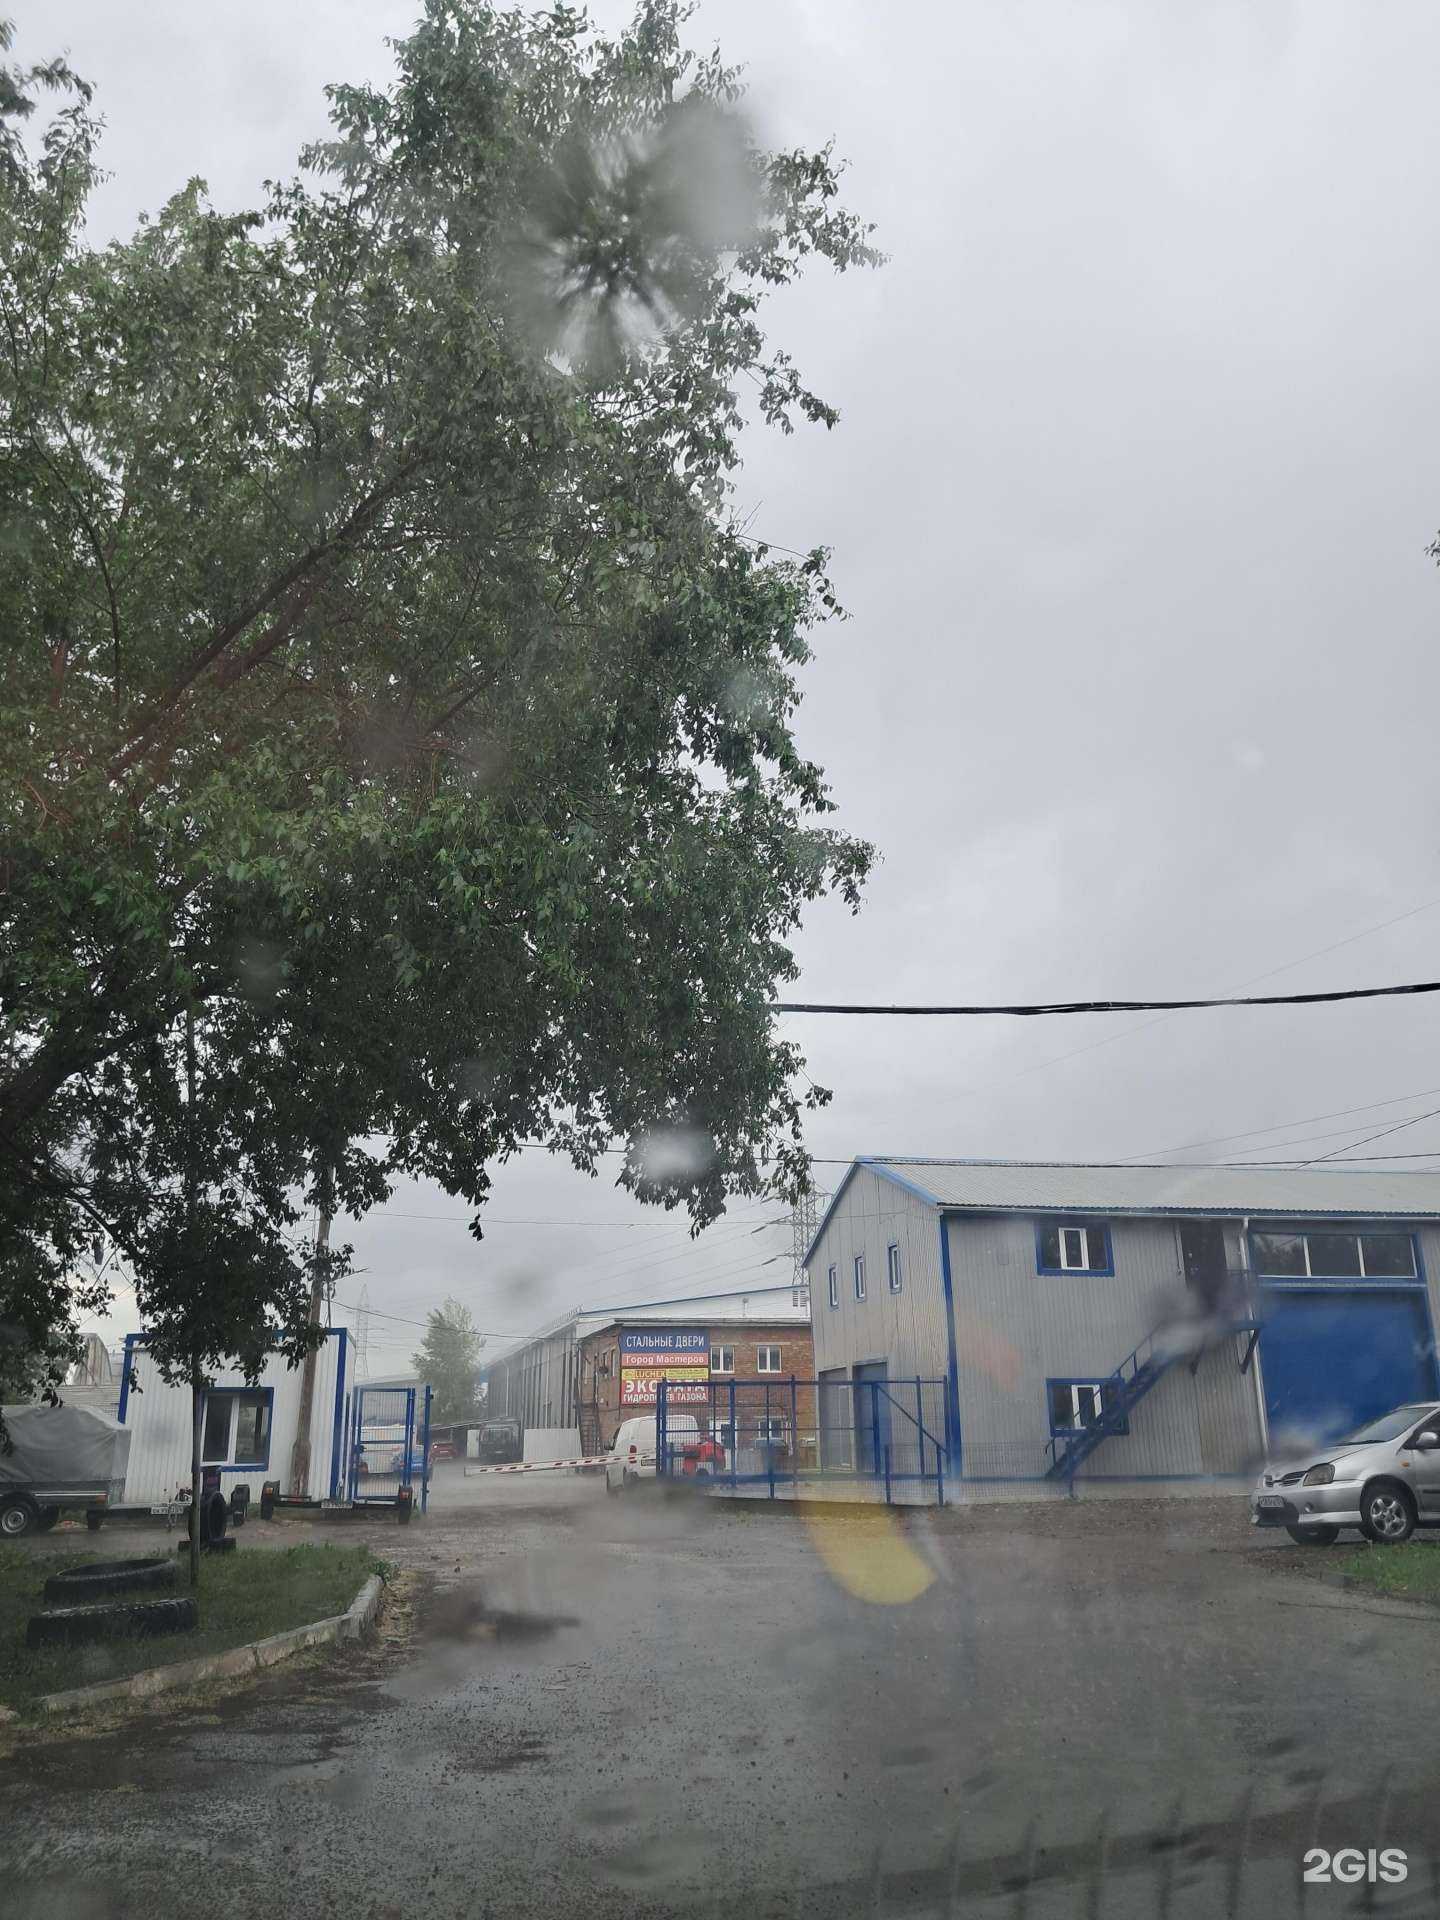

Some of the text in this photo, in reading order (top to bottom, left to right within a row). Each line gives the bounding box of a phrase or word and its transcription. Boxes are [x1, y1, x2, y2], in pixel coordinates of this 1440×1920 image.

[626, 1335, 705, 1348] СТАЛЬНЫЕ ДВЕРИ
[626, 1355, 704, 1365] Город Мастеров
[623, 1392, 708, 1403] ГИДРОПЕВ ГАЗОНА
